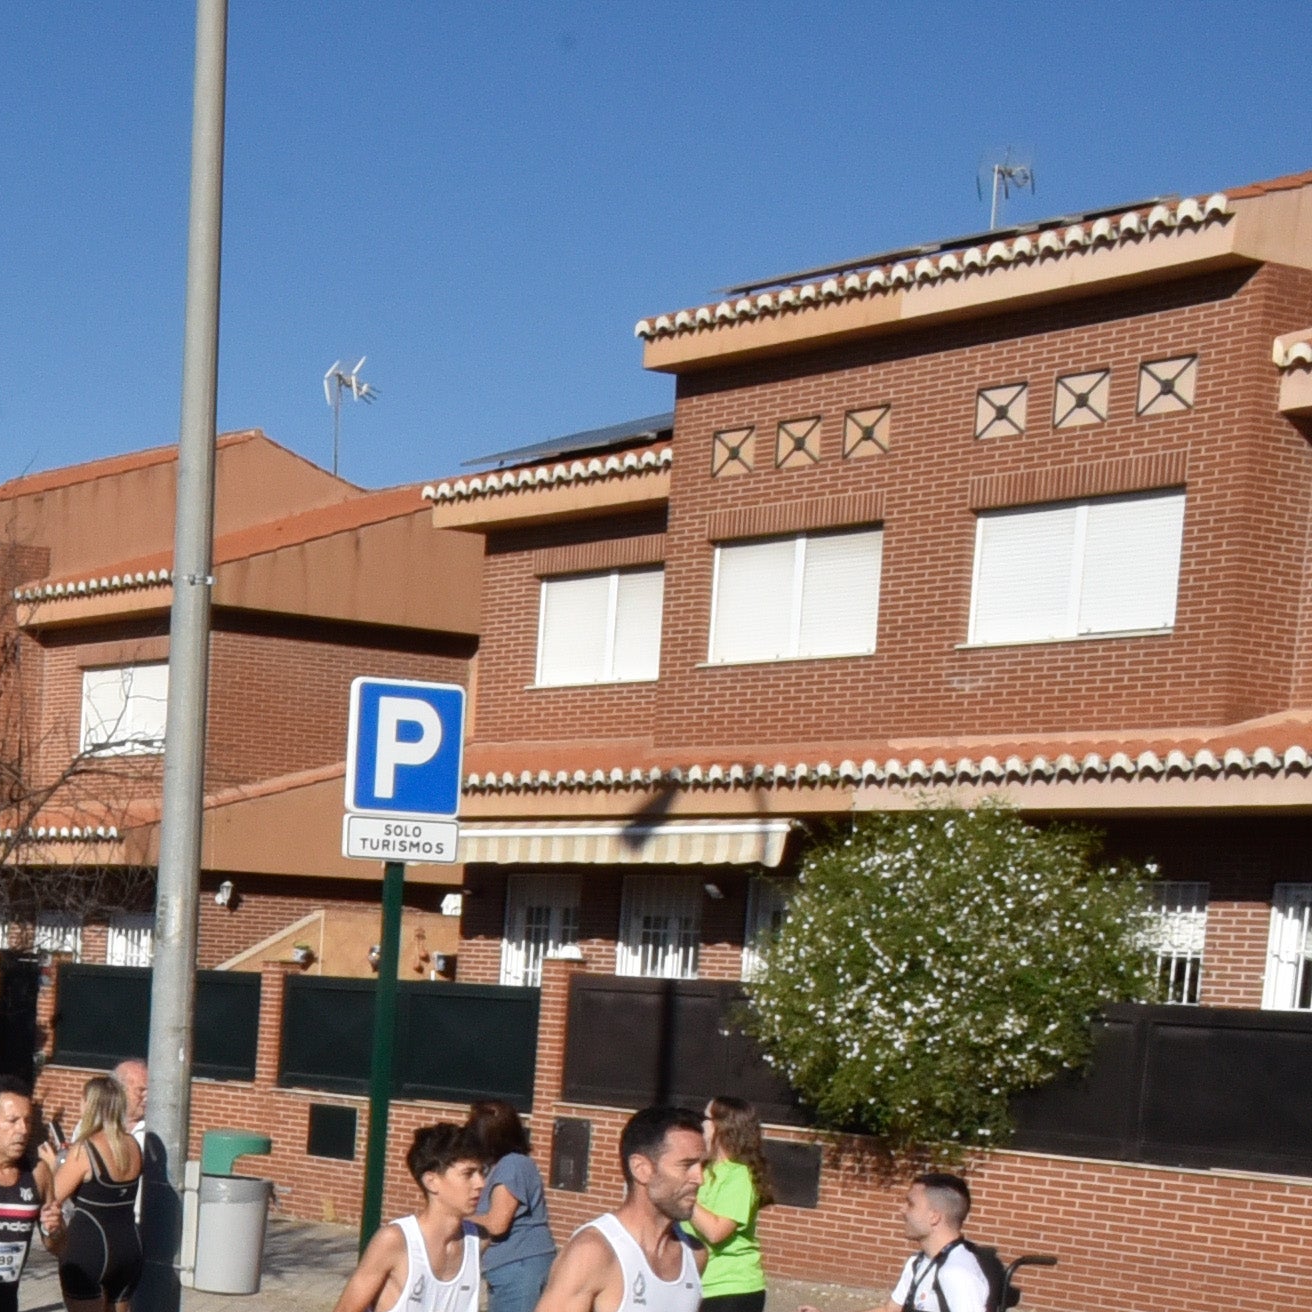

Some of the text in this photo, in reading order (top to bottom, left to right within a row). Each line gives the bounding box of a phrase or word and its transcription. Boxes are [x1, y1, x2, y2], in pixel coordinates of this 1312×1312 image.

[374, 696, 442, 798] P
[384, 824, 422, 837] SOLO
[360, 838, 444, 855] TURISMOS
